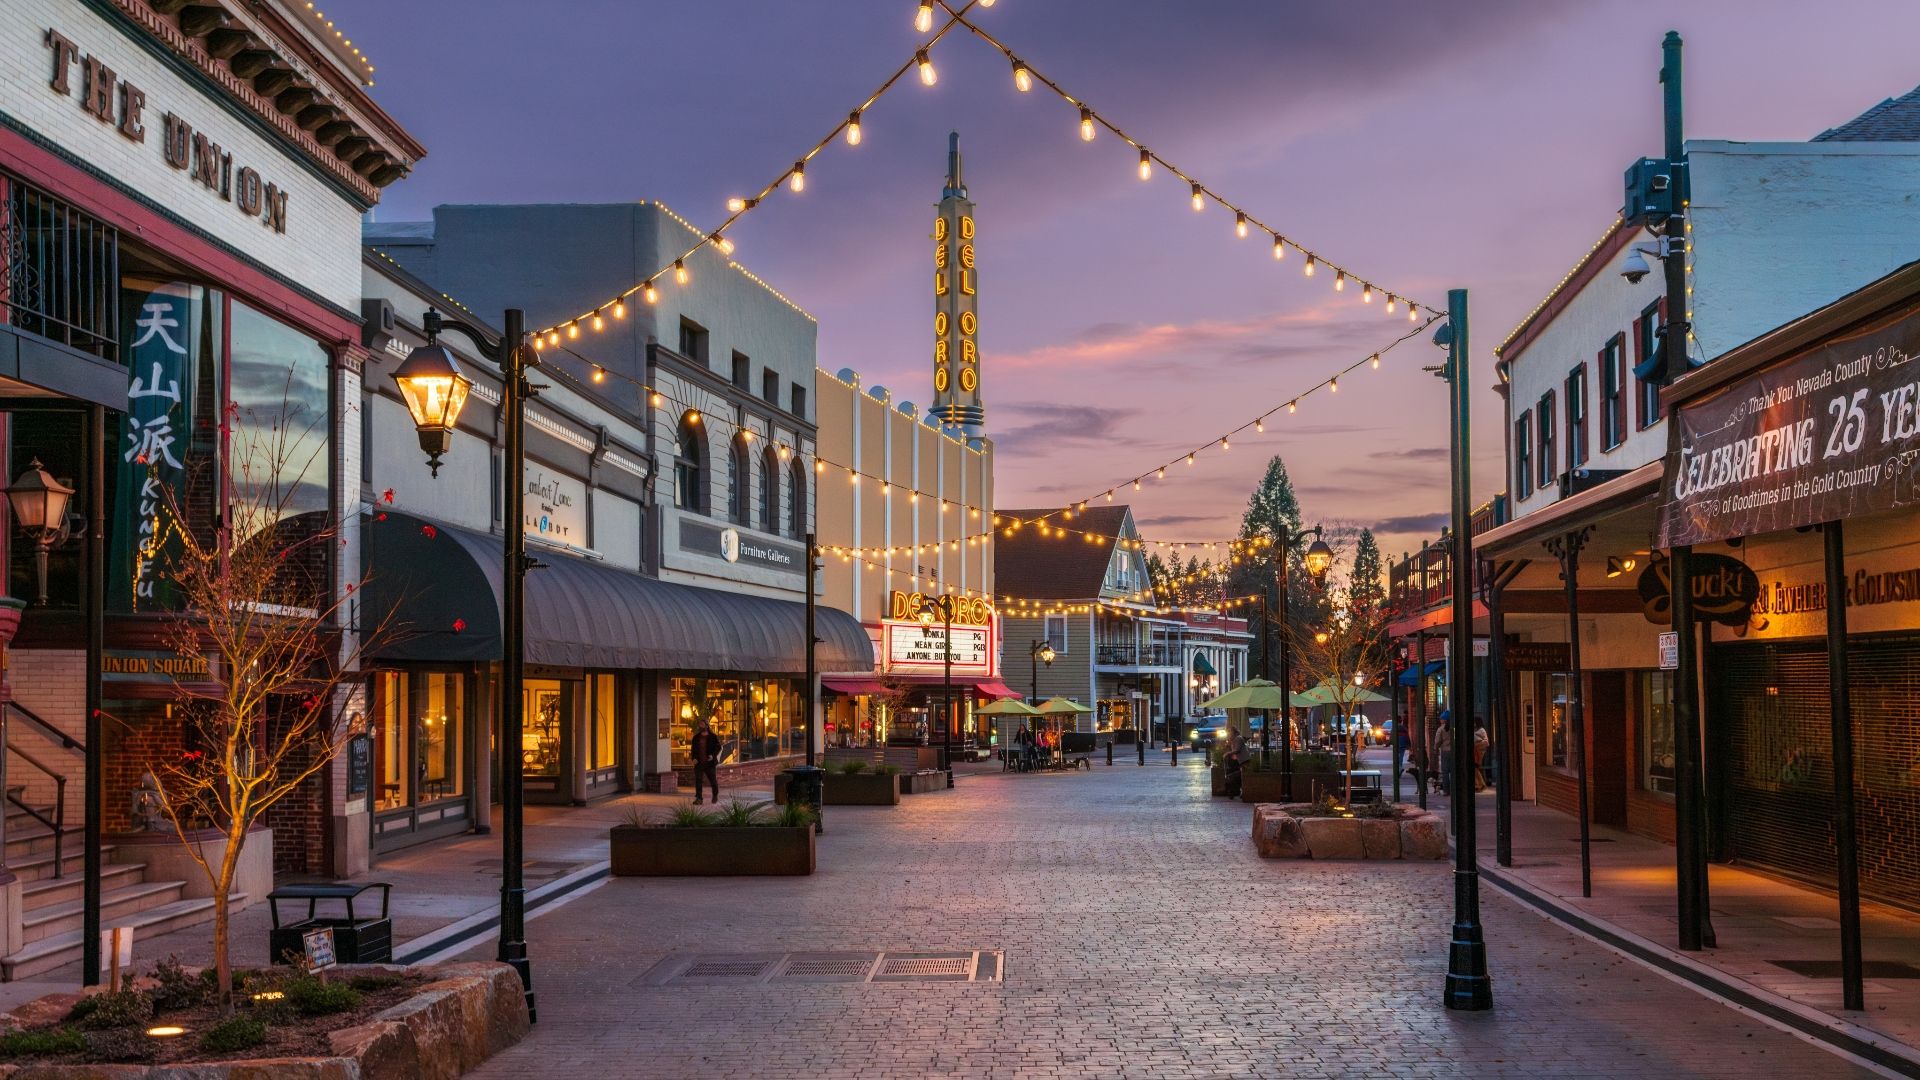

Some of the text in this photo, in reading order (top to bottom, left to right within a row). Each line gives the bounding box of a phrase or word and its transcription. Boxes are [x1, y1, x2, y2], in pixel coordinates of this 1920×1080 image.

[50, 27, 289, 235] THE UNION
[935, 217, 949, 295] DEL
[960, 215, 975, 295] DEL
[935, 312, 949, 391] ORO
[960, 312, 976, 391] ORO
[125, 302, 187, 470] 天山派
[1748, 354, 1873, 414] Thank You Nevada County
[1675, 418, 1814, 500] CELEBRATING
[1823, 388, 1869, 460] 25
[1722, 464, 1881, 514] of Goodtimes in the Gold Country
[137, 560, 155, 599] FU
[740, 542, 766, 560] Furniture
[767, 548, 791, 565] Galleries
[939, 595, 988, 626] ORO
[973, 632, 982, 641] PG
[101, 656, 149, 673] UNION
[906, 652, 932, 661] ANYONE
[935, 641, 953, 650] GIRS
